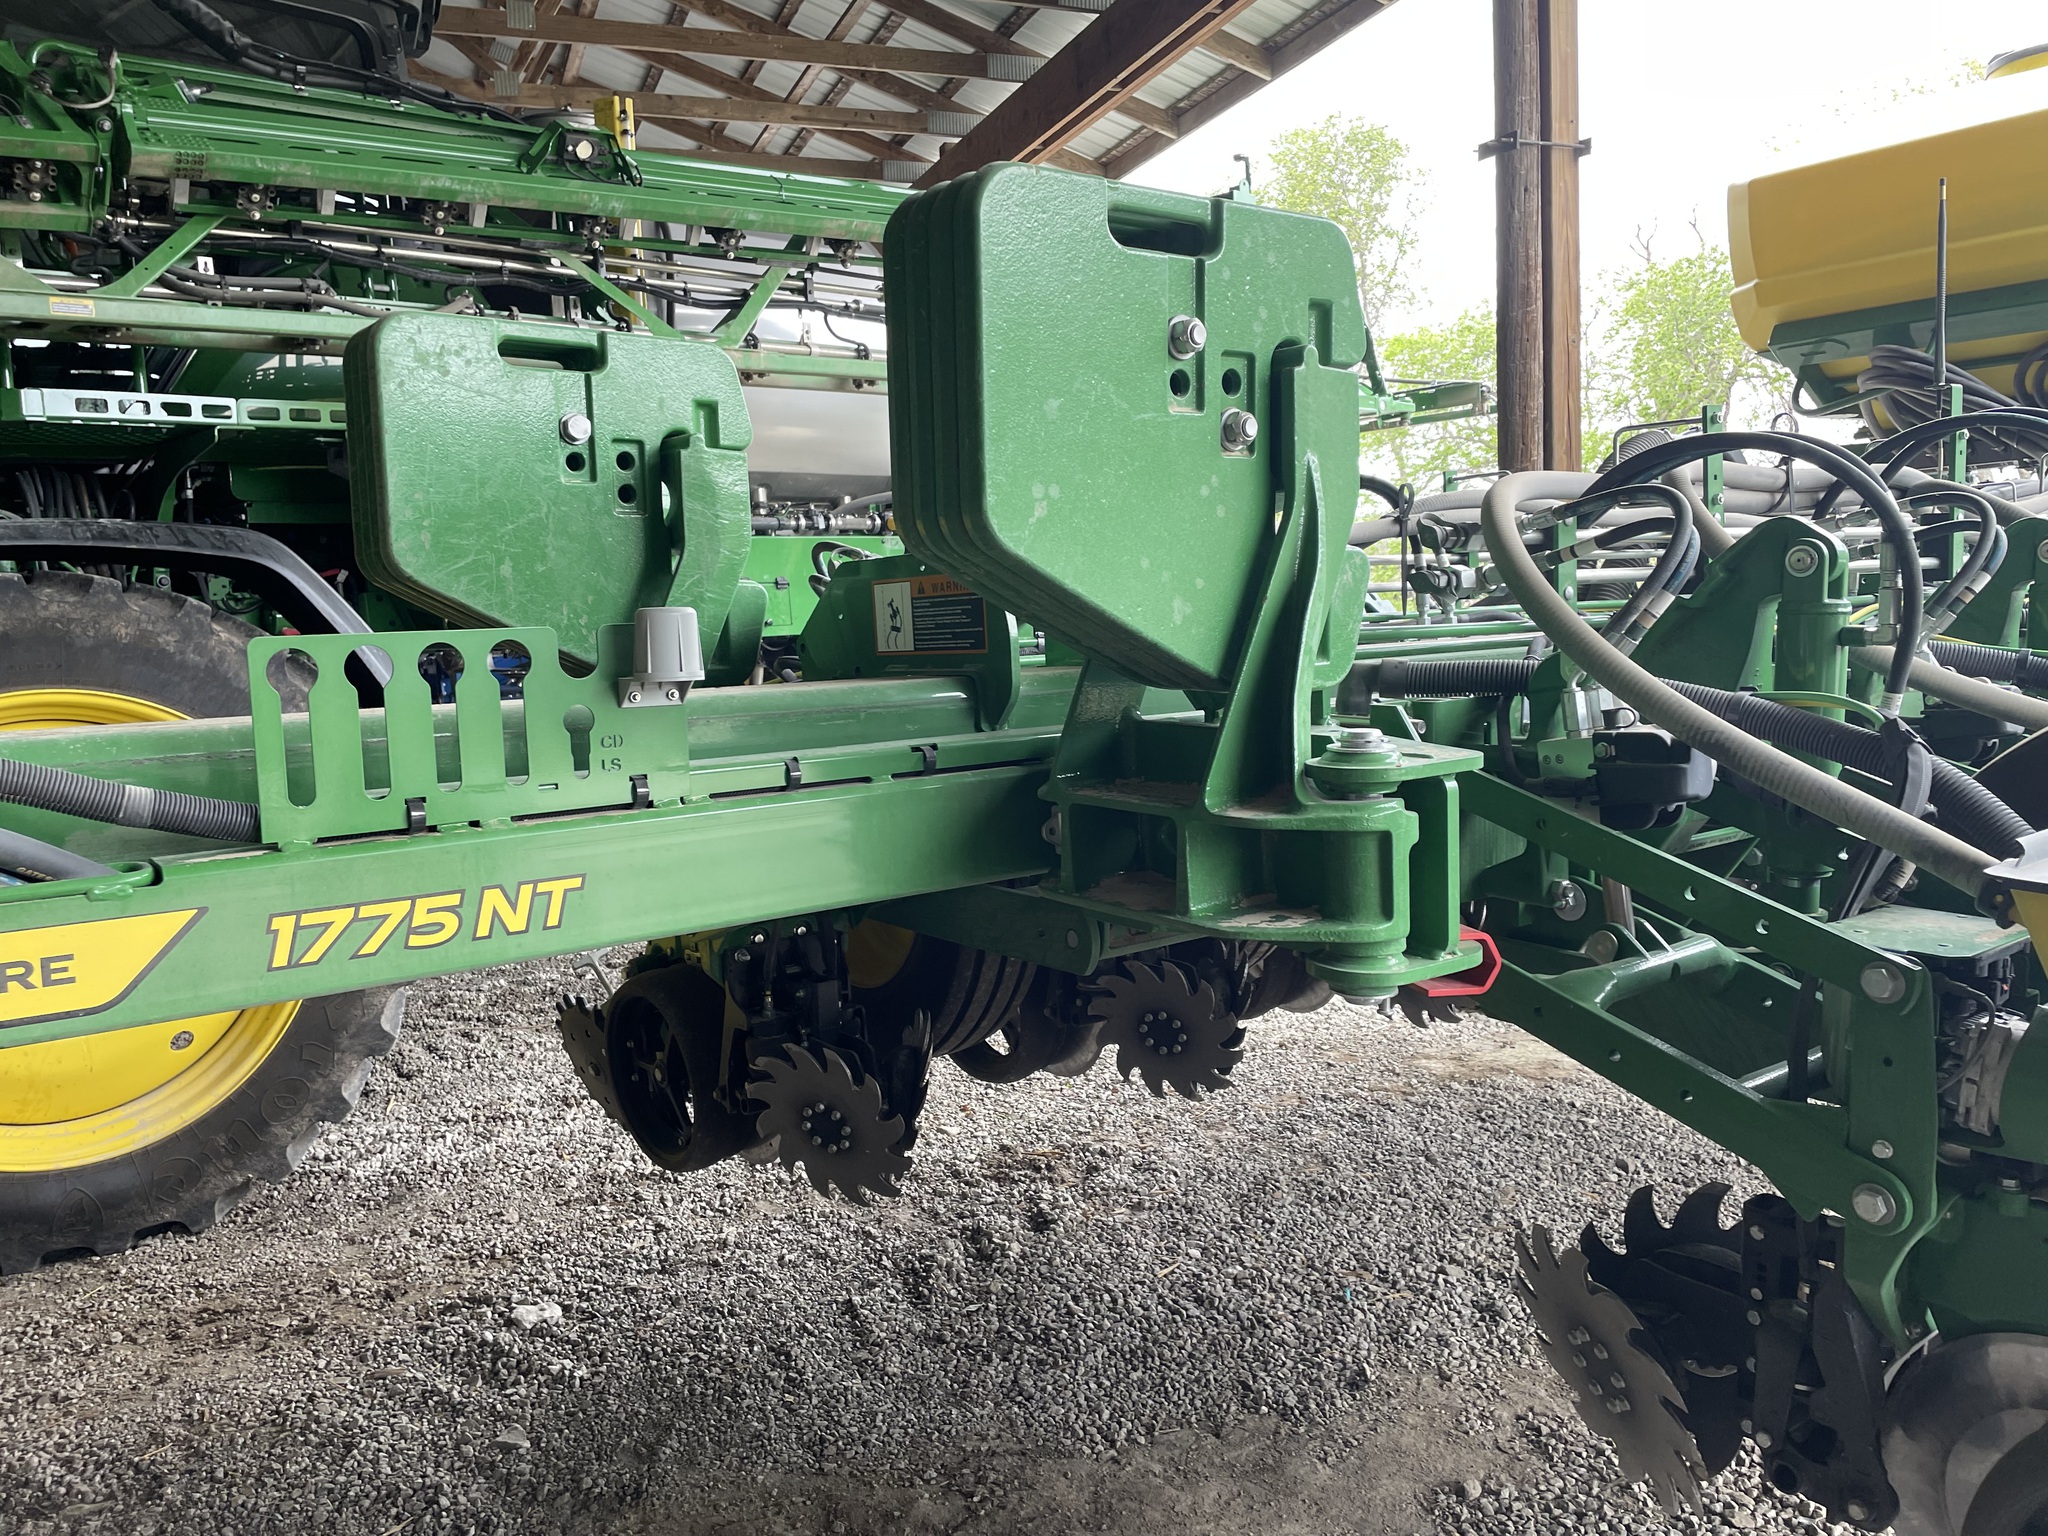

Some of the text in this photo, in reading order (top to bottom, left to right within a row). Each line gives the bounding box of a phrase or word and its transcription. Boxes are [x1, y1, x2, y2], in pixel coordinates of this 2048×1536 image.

[932, 581, 970, 594] WARNI
[600, 733, 624, 749] CD
[601, 758, 622, 772] LS
[265, 872, 587, 972] 1775 NT
